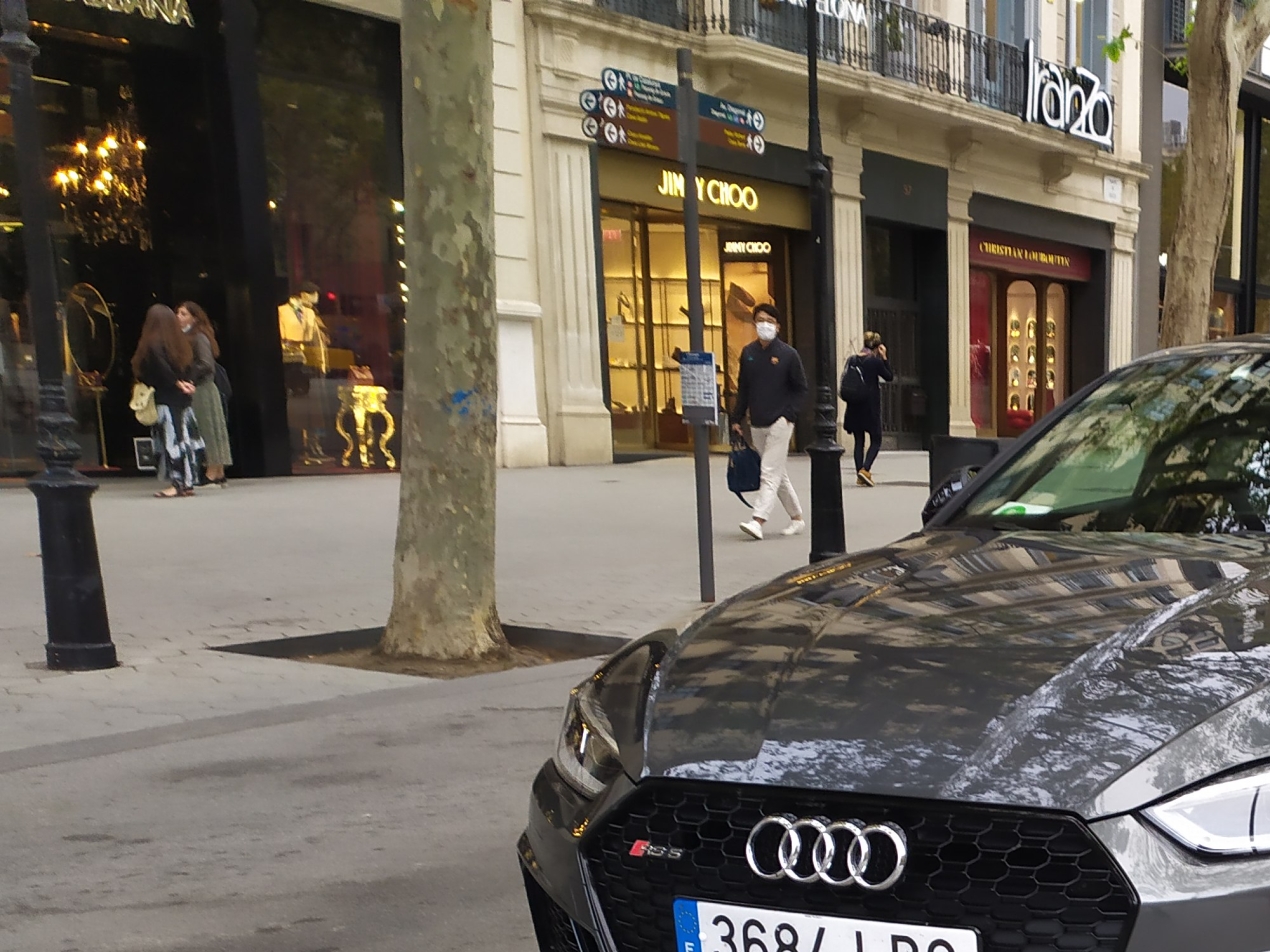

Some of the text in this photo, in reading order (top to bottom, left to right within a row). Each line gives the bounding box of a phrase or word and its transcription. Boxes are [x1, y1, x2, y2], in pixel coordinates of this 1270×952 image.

[658, 169, 758, 211] JIMY CHOO
[746, 241, 772, 254] CHOO
[979, 241, 1070, 267] CHRISTIAN LOUBOUTIN
